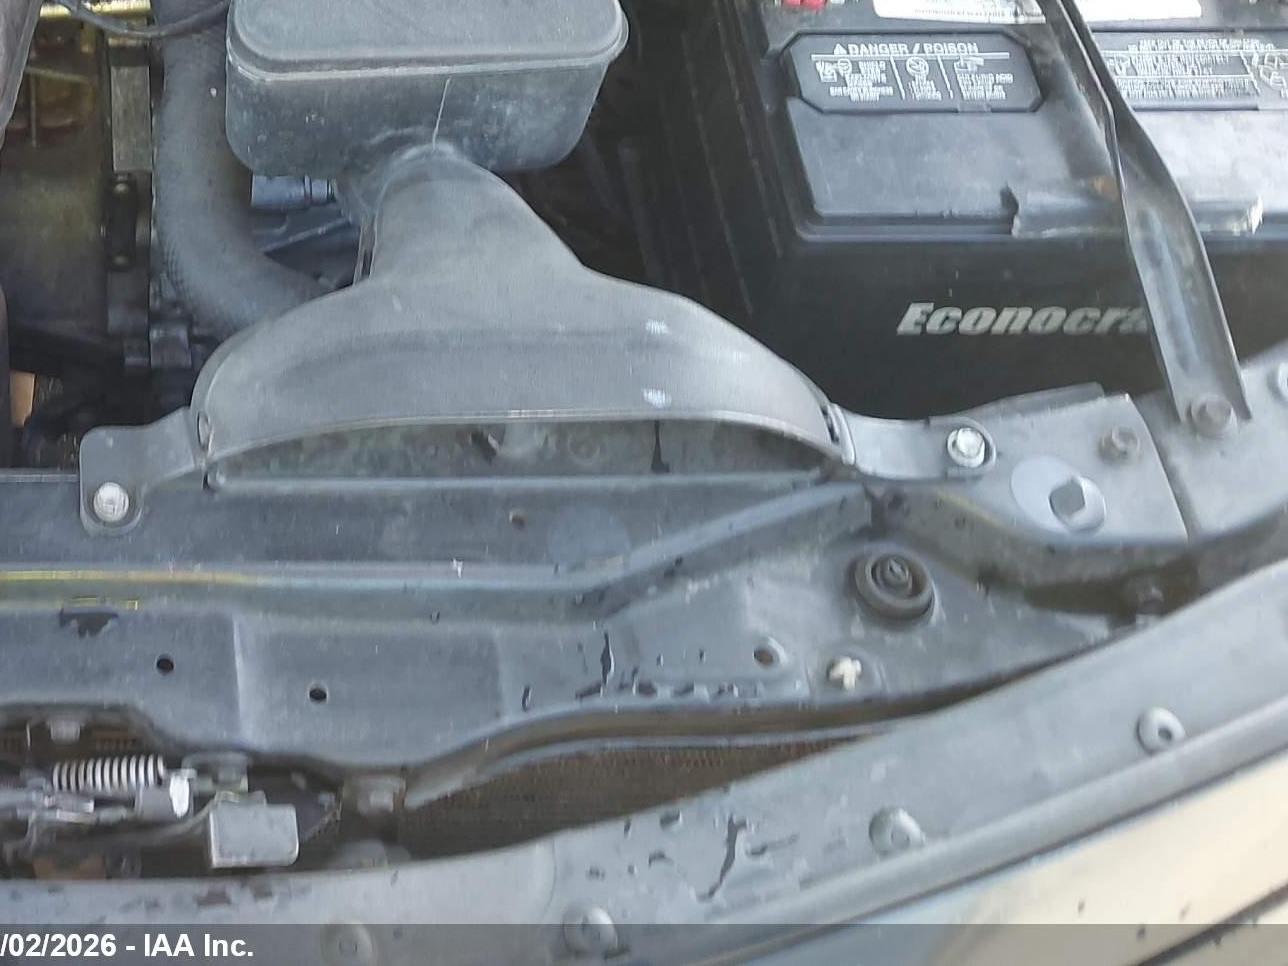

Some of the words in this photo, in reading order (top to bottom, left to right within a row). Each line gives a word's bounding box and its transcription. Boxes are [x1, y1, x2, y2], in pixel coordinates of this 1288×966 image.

[848, 43, 909, 55] DANGER
[924, 42, 979, 55] POISON
[896, 302, 1150, 335] Econocra
